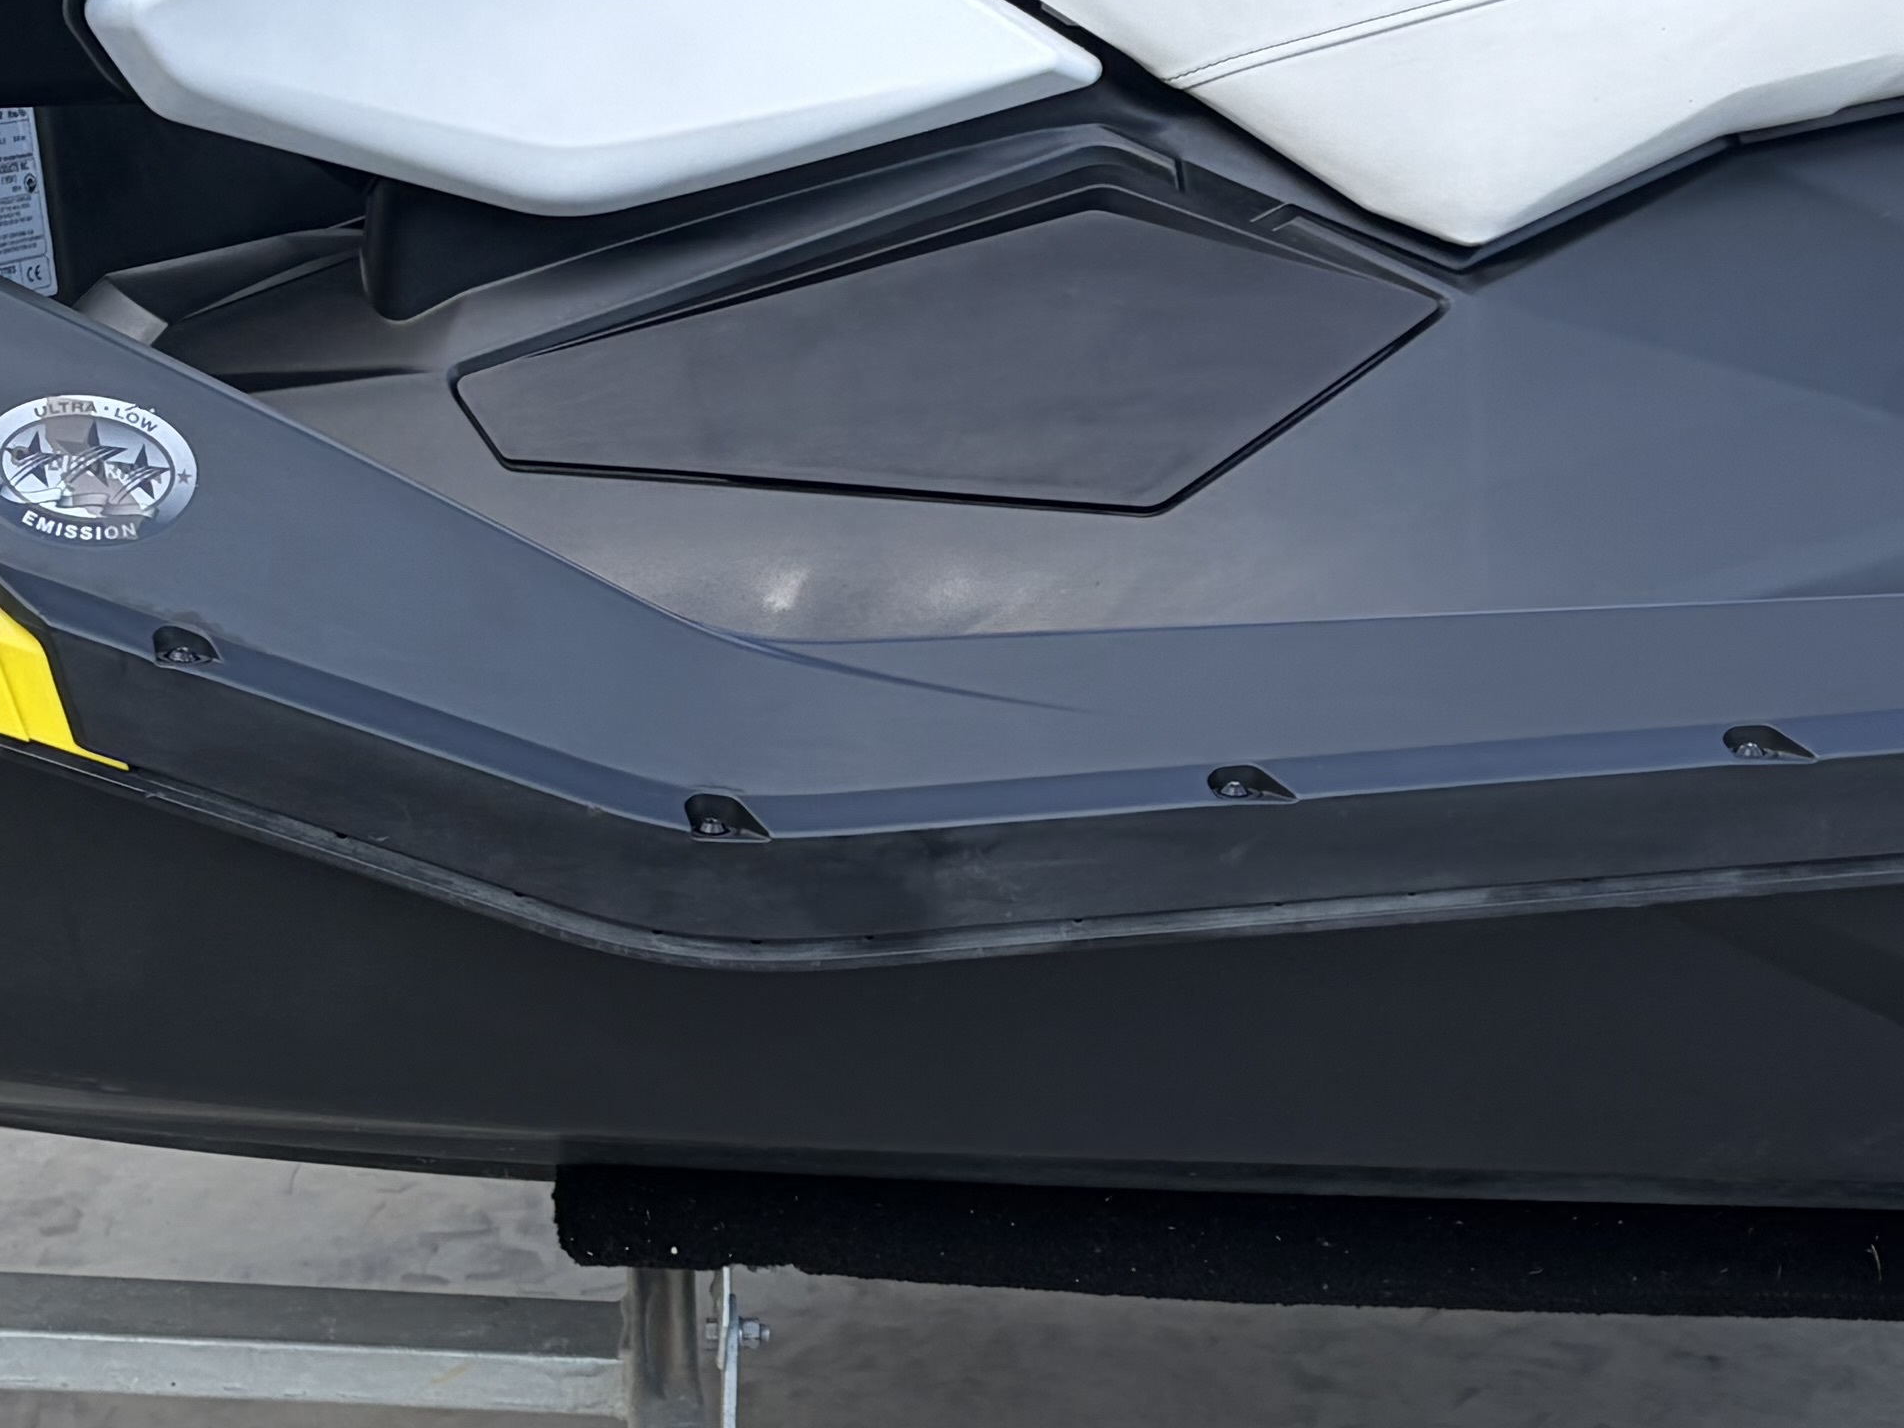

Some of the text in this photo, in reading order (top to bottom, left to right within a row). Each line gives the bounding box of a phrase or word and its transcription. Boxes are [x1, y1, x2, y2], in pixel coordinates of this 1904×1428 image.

[27, 265, 42, 283] CE
[33, 400, 158, 433] ULTRA LOW
[21, 509, 138, 541] EMISSION
